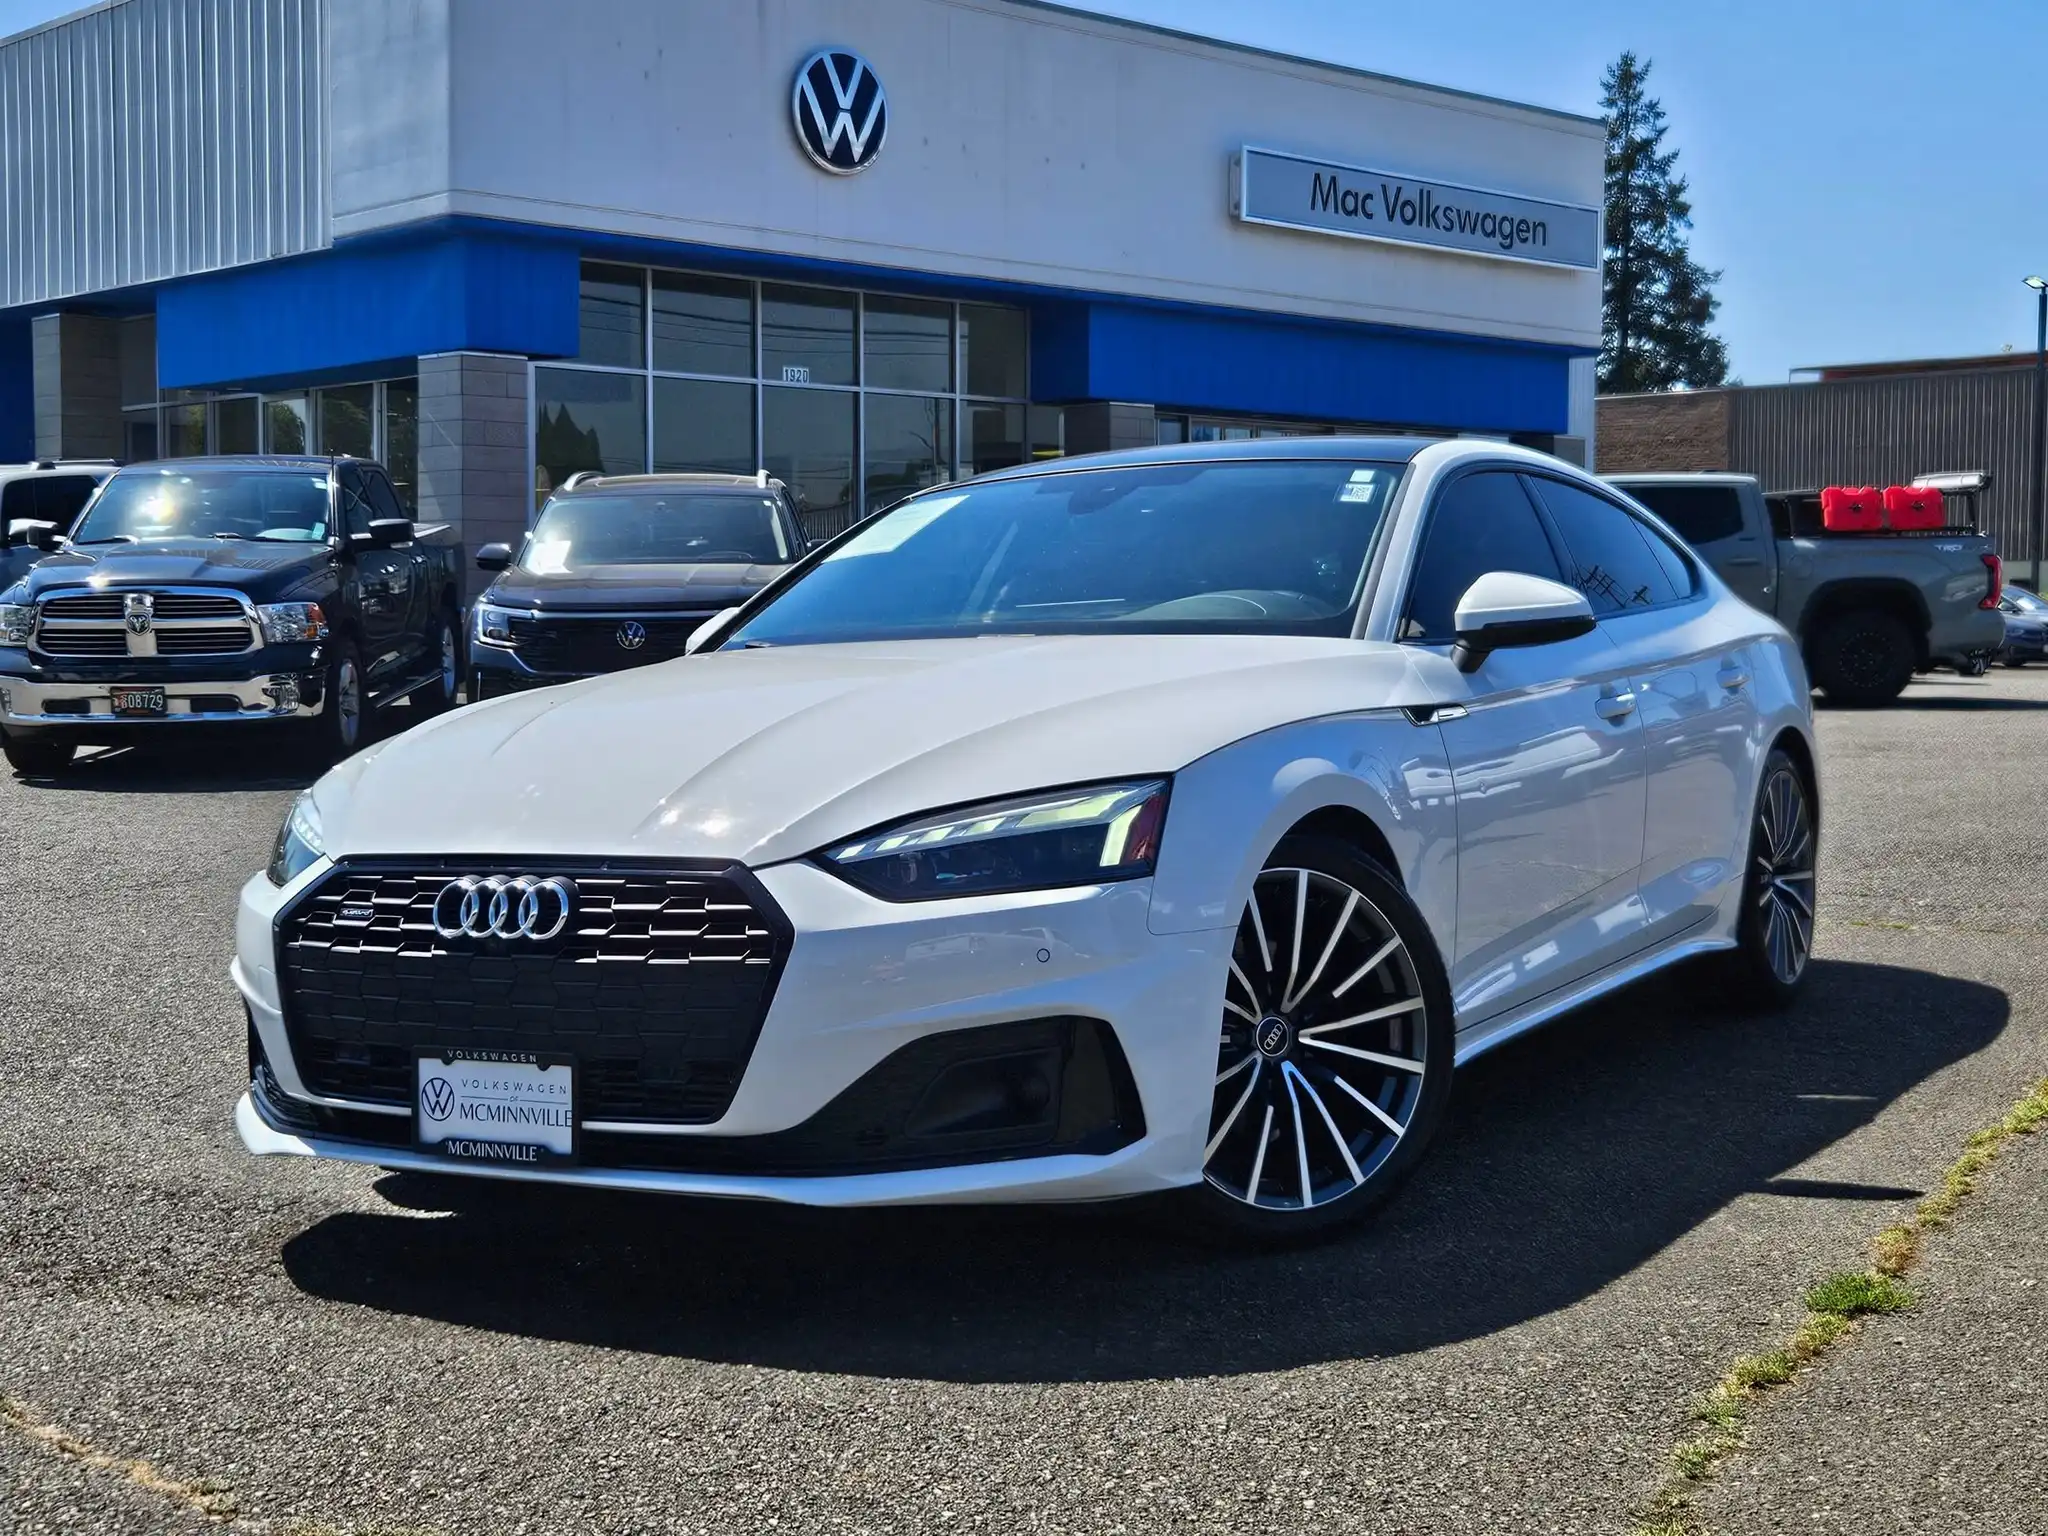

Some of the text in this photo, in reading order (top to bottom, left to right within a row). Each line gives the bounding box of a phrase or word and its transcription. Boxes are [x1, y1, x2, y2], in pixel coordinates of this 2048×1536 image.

[797, 51, 886, 164] VW
[1310, 172, 1547, 250] Mac Volkswagen
[784, 368, 808, 382] 1920
[447, 1050, 537, 1063] VOLKSWAGEN
[461, 1078, 567, 1095] VOLKSWAGEN
[459, 1102, 573, 1128] MCMINNVILLE
[447, 1140, 537, 1162] MCMINNVILLE
